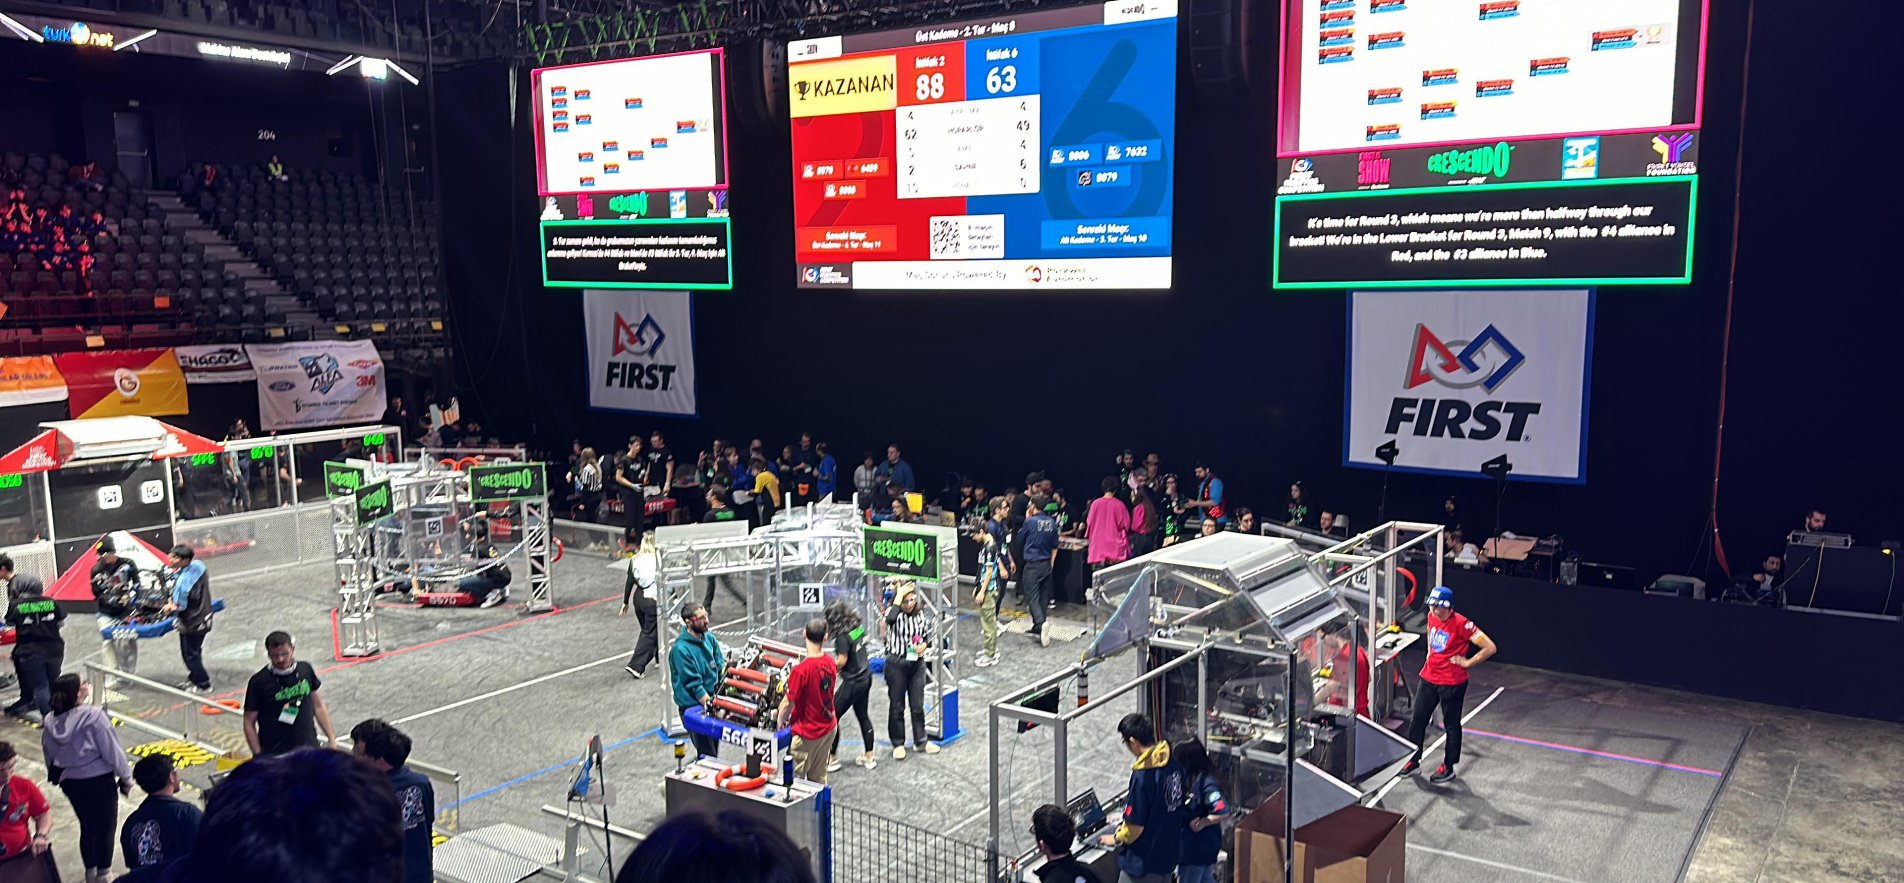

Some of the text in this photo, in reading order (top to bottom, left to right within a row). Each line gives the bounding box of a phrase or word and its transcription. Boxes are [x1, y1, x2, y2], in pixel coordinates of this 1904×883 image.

[972, 25, 986, 35] Tur
[1011, 47, 1018, 58] 6
[939, 55, 945, 67] 2
[814, 74, 894, 97] KAZANAN
[916, 72, 944, 100] 88
[986, 65, 1016, 94] 63
[1020, 102, 1026, 111] 4
[908, 111, 914, 120] 4
[1016, 120, 1030, 131] 49
[258, 130, 275, 140] 204
[904, 129, 917, 140] 62
[1020, 140, 1026, 149] 4
[908, 165, 914, 176] 2
[1020, 159, 1026, 170] 6
[1358, 158, 1391, 185] SHOW
[1308, 217, 1322, 229] It's
[1323, 217, 1343, 228] time
[1344, 216, 1359, 227] for
[1359, 214, 1390, 226] Round
[1401, 212, 1430, 224] which
[1430, 214, 1463, 223] means
[1464, 210, 1492, 222] we're
[1492, 211, 1520, 221] more
[1521, 208, 1545, 220] than
[1545, 207, 1587, 220] halfway
[1588, 204, 1632, 219] through
[1632, 206, 1653, 216] our
[1352, 234, 1362, 245] in
[1363, 233, 1378, 244] the
[1379, 233, 1409, 244] Lower
[1409, 230, 1447, 243] Bracket
[1448, 230, 1463, 241] for
[1464, 228, 1496, 241] Round
[1508, 227, 1542, 239] Match
[1554, 226, 1578, 238] with
[1579, 225, 1598, 238] the
[1618, 224, 1662, 236] alliance
[1662, 223, 1676, 236] in
[1391, 250, 1413, 262] Red,
[1414, 249, 1433, 260] and
[1433, 249, 1450, 260] the
[1468, 248, 1508, 259] alliance
[1508, 247, 1519, 258] in
[1520, 246, 1547, 258] Blue.
[356, 374, 376, 387] 3M
[605, 361, 676, 392] FIRST
[1384, 397, 1542, 442] FIRST
[480, 468, 532, 490] CRESCENDO
[873, 538, 925, 566] CRESCENDO
